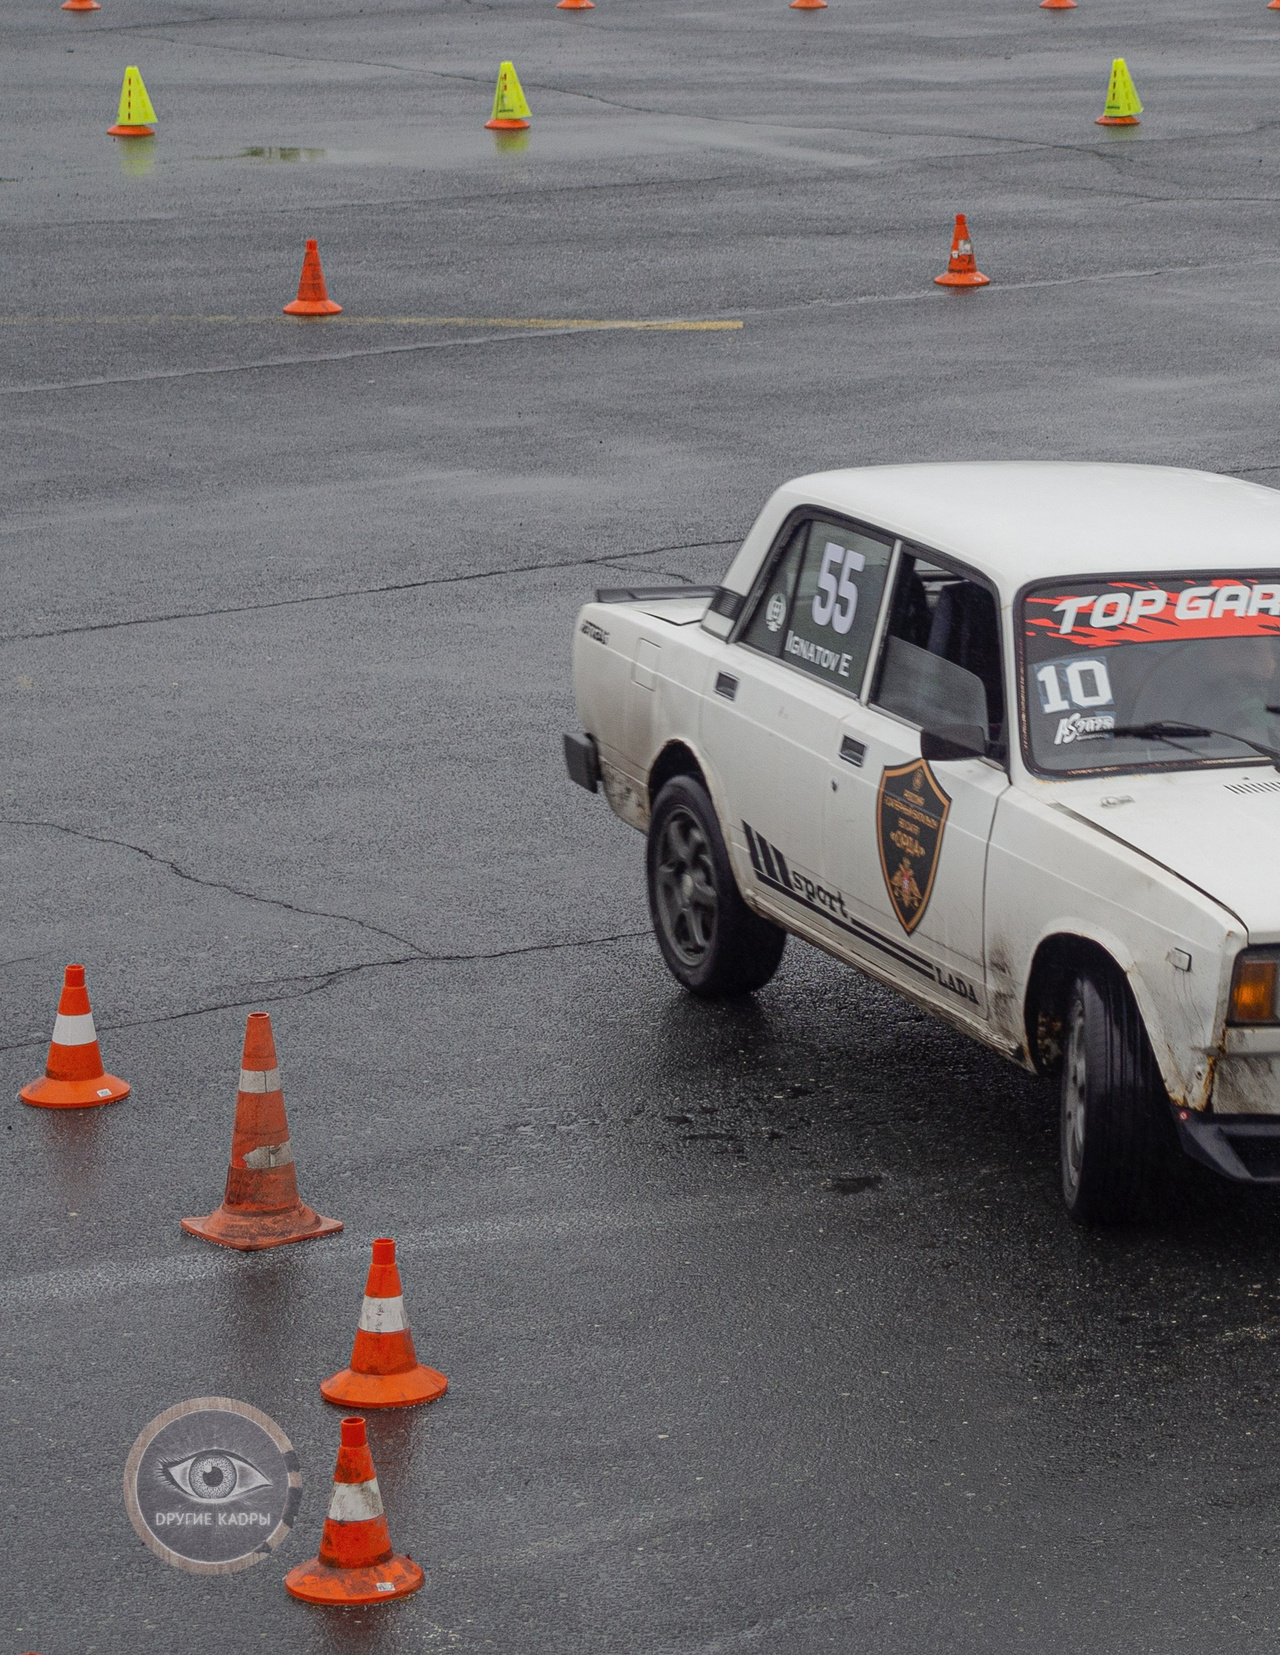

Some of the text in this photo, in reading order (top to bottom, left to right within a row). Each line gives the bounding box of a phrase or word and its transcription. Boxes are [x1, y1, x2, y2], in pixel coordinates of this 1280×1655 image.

[812, 542, 866, 634] 55
[1052, 589, 1168, 635] TOP
[838, 652, 853, 677] E
[1037, 660, 1113, 713] 10
[791, 870, 848, 918] sport
[935, 966, 979, 1005] LADA
